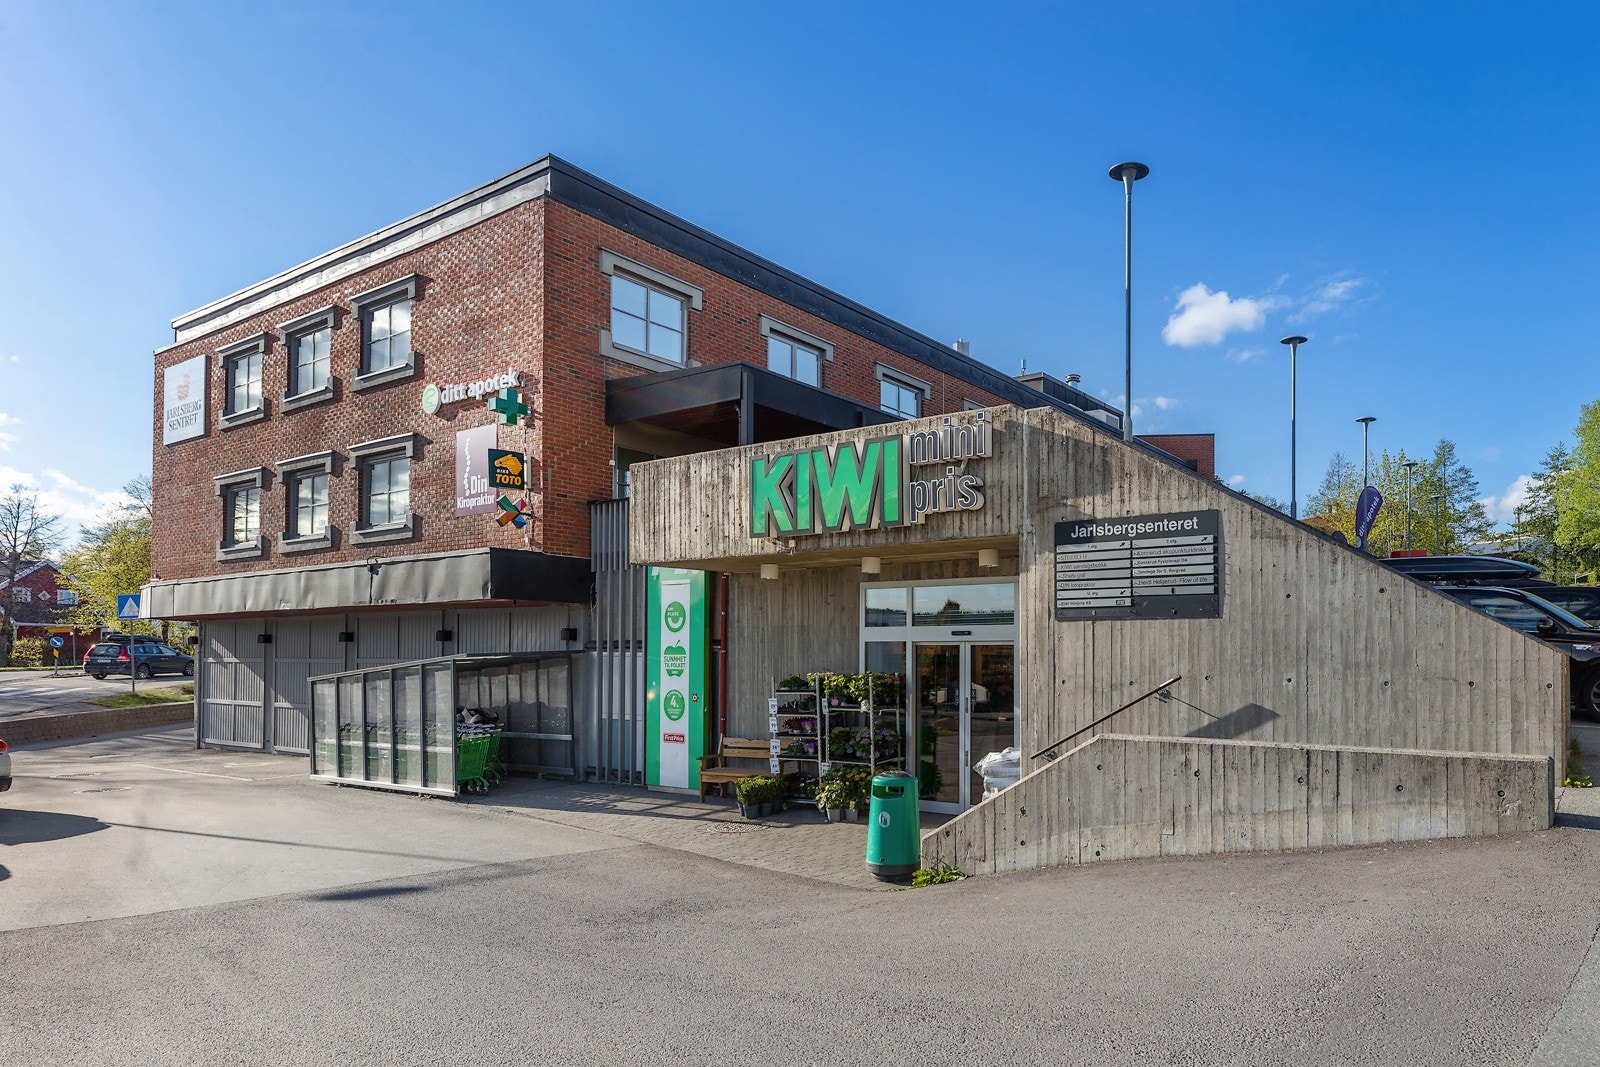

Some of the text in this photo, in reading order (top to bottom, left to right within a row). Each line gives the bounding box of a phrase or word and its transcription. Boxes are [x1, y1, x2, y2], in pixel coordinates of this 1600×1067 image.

[441, 367, 520, 404] ditt apotek
[166, 399, 202, 422] JARLSBERG
[168, 413, 199, 431] SENTRET
[909, 411, 988, 464] mini
[470, 475, 488, 495] Din
[495, 473, 522, 486] TOTO
[749, 434, 905, 538] KIWI
[456, 494, 495, 510] Kiropraktor
[909, 466, 982, 523] pris
[1366, 496, 1380, 522] apotek
[1070, 516, 1199, 538] Jarlsbergsenteret
